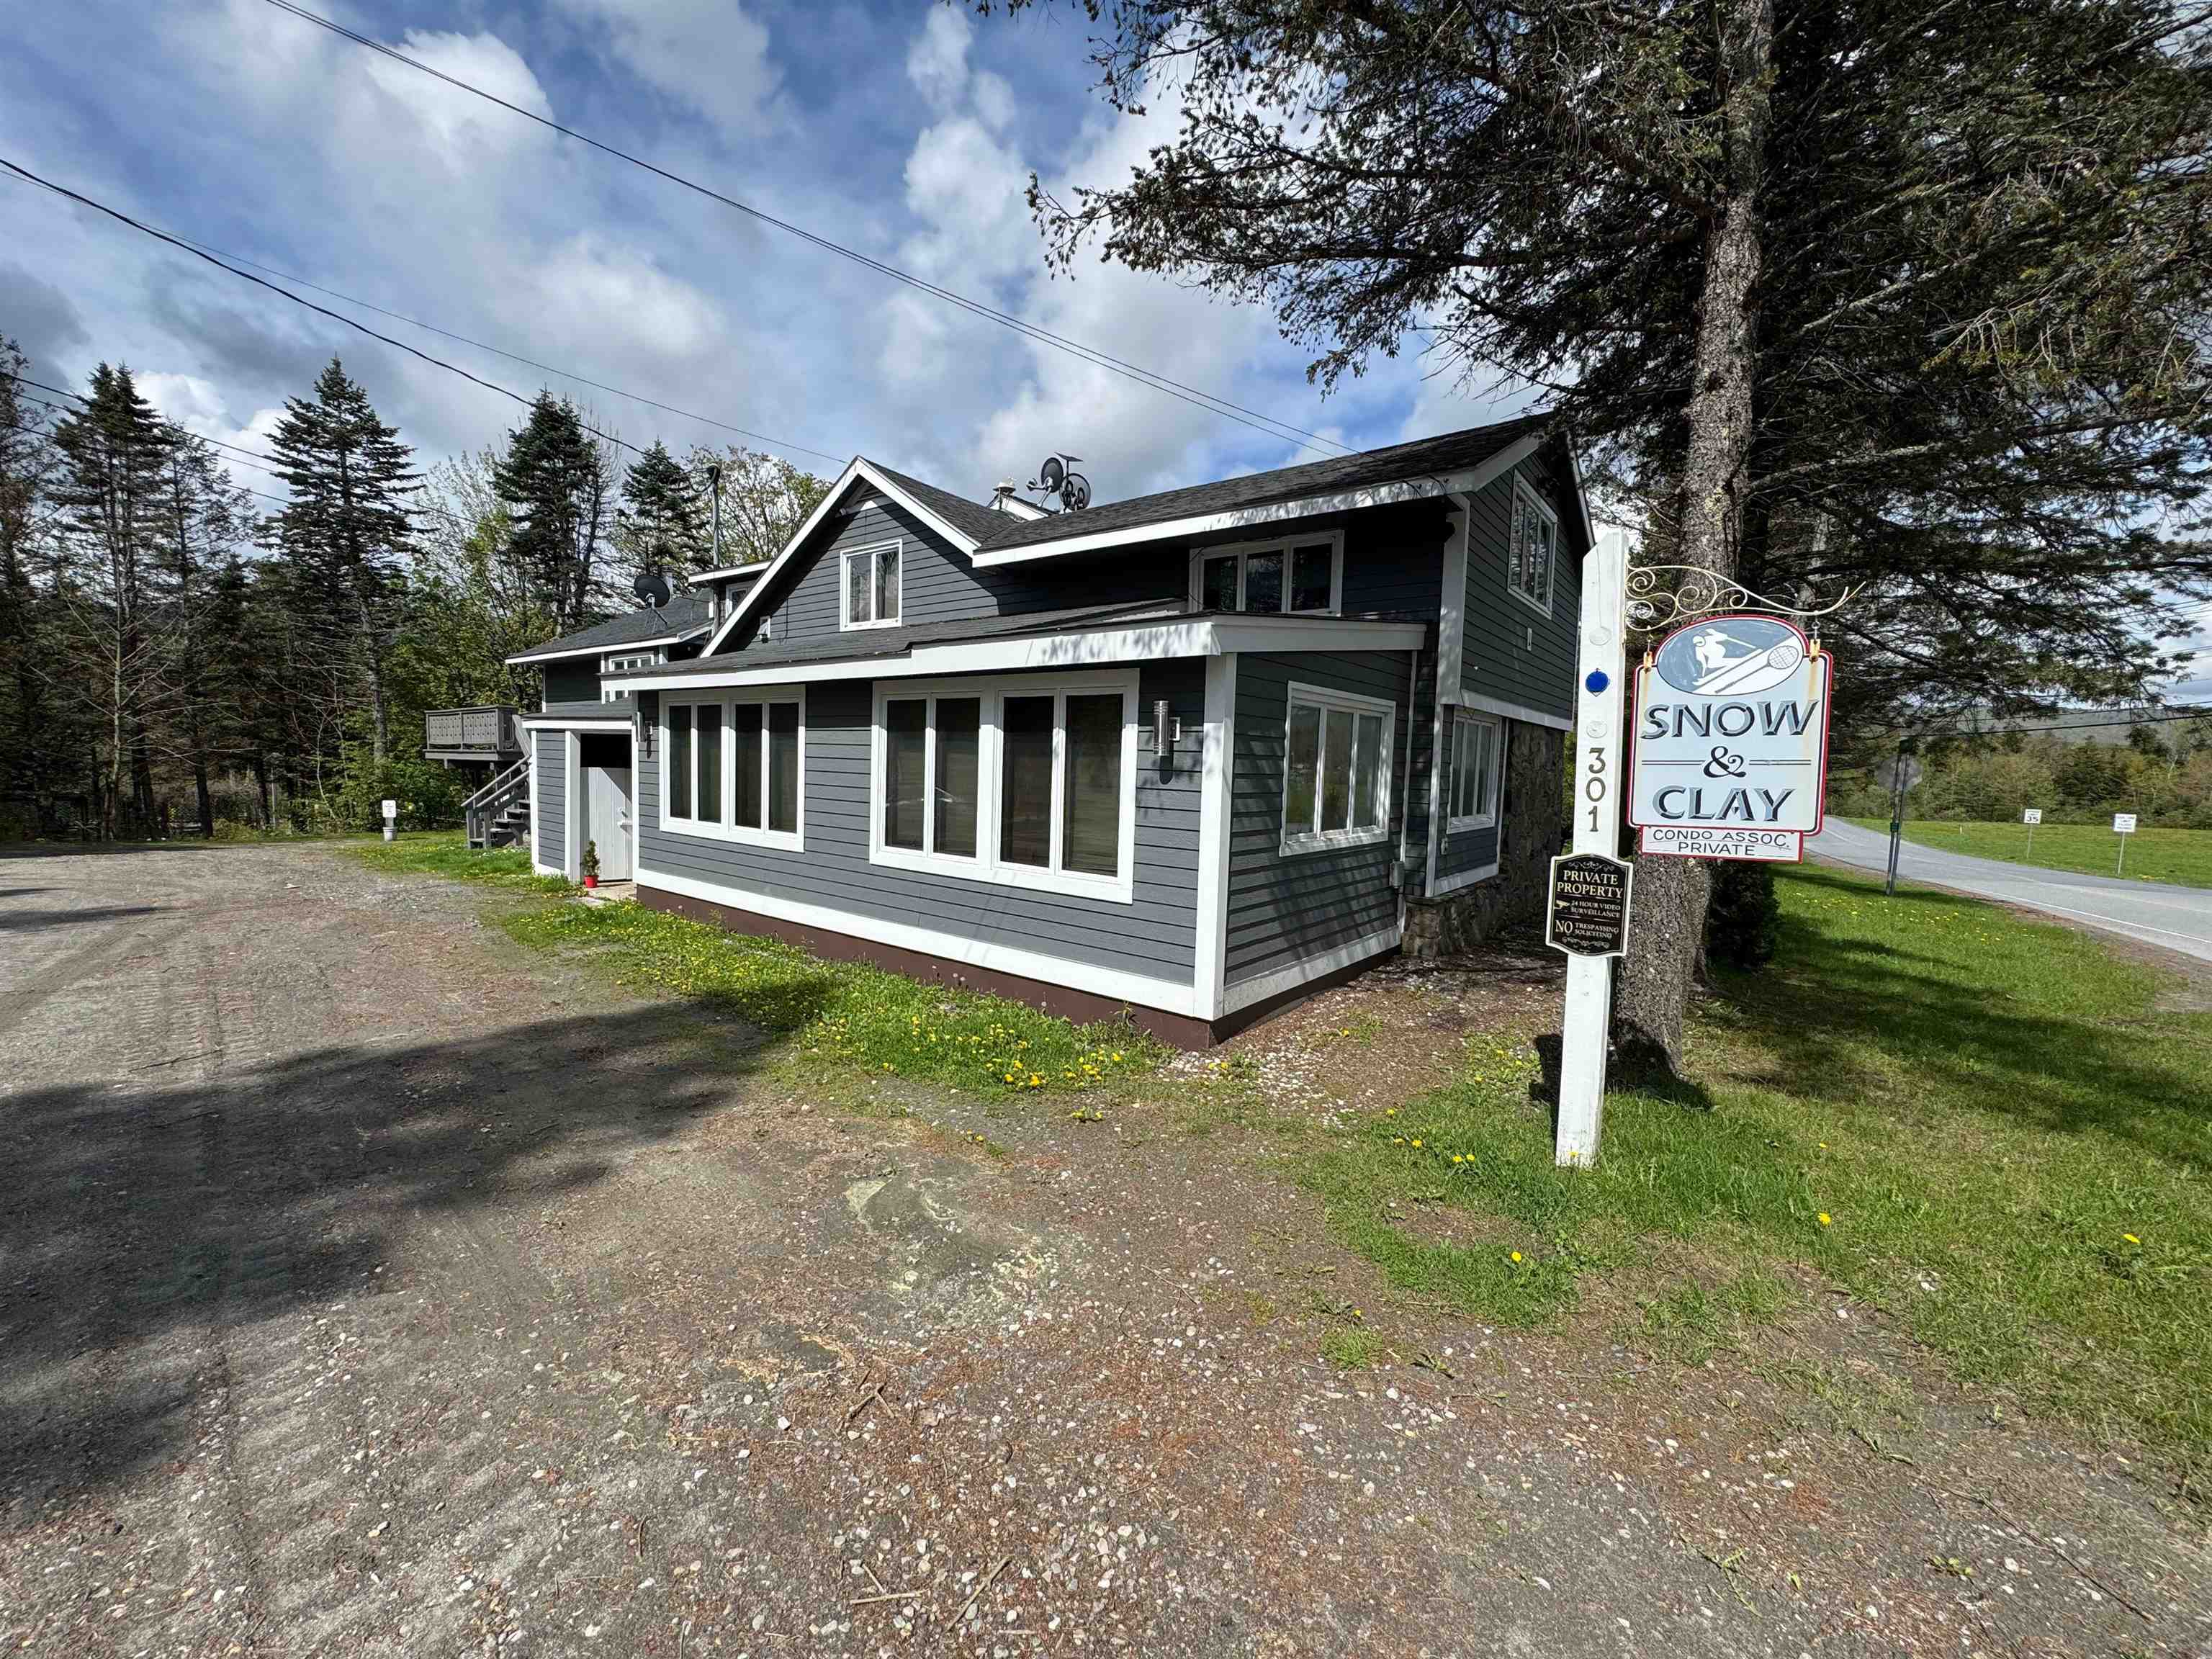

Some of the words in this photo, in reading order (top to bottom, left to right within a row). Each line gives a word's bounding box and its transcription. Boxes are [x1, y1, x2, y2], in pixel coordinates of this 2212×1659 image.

[1640, 699, 1820, 739] SNOW
[1703, 746, 1746, 778] &
[1586, 747, 1606, 832] 301
[1653, 785, 1797, 822] CLAY
[1653, 829, 1713, 841] CONDO
[1722, 832, 1790, 848] ASSOC.
[1678, 841, 1755, 856] PRIVATE
[1563, 870, 1619, 885] PRIVATE
[1557, 882, 1624, 899] PROPERTY
[1571, 907, 1621, 918] SURVEILLANCE
[1555, 920, 1573, 934] NO
[1575, 922, 1619, 934] TRESPASSING
[1575, 929, 1612, 939] SOLICITING
